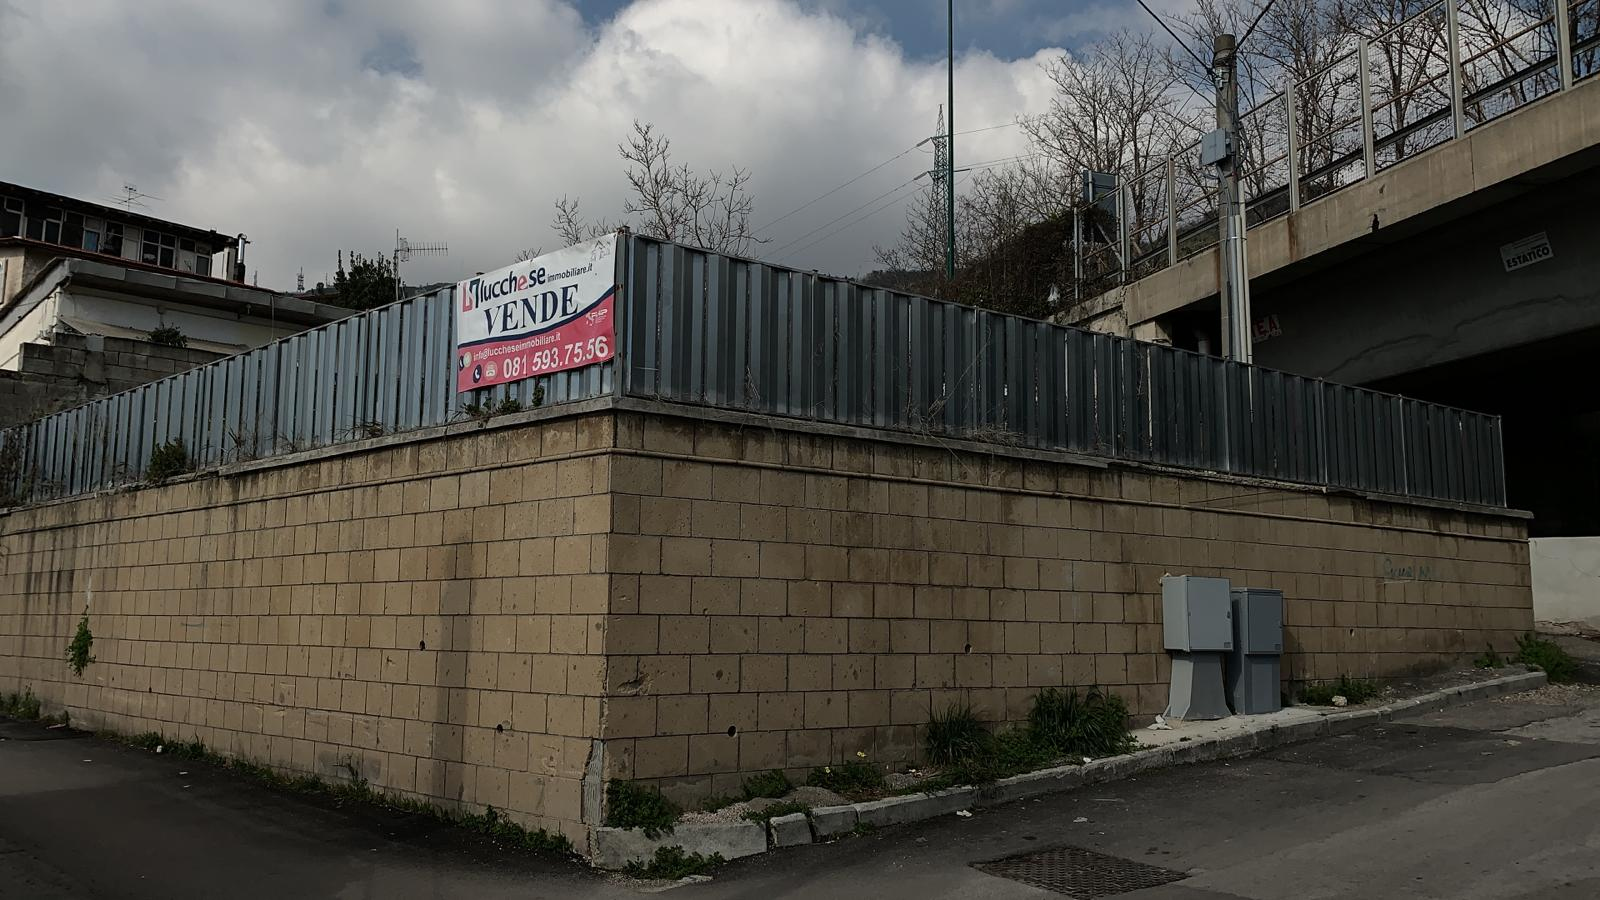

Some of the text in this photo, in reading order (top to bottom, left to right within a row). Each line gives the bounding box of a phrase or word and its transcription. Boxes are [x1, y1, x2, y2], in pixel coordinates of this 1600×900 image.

[1506, 246, 1550, 268] ESTATICO
[480, 262, 593, 303] lucchese immobiliare.it
[484, 284, 579, 336] VENDE
[473, 332, 561, 361] info@luccheseimmobiliare.it
[503, 335, 609, 379] 081 593.75.56
